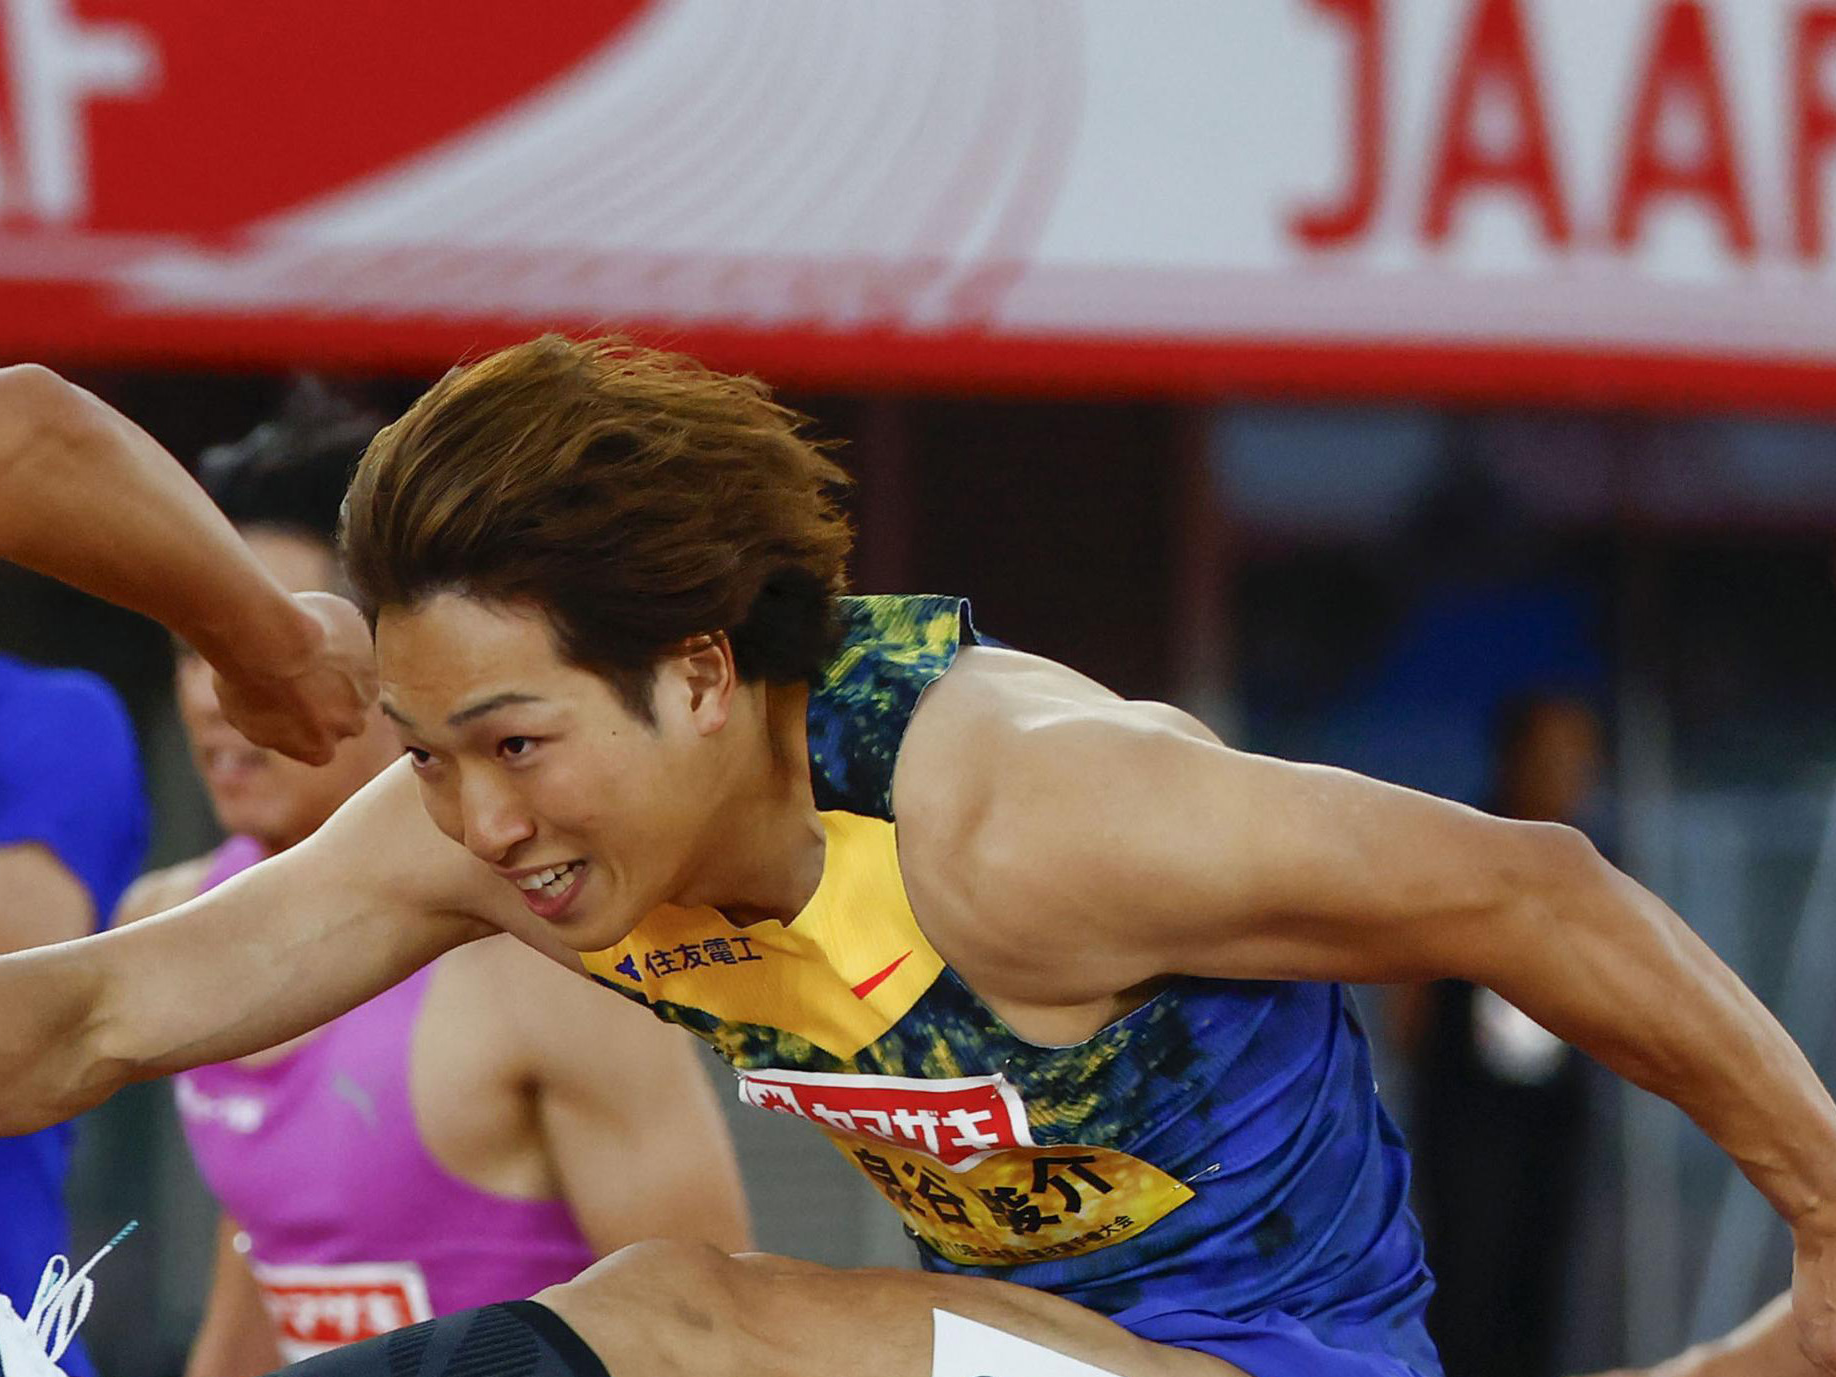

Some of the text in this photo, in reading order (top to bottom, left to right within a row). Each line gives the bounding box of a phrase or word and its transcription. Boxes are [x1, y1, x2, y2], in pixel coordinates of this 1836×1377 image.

[645, 936, 763, 979] 住友電工
[810, 1101, 1000, 1155] ヤマザキ
